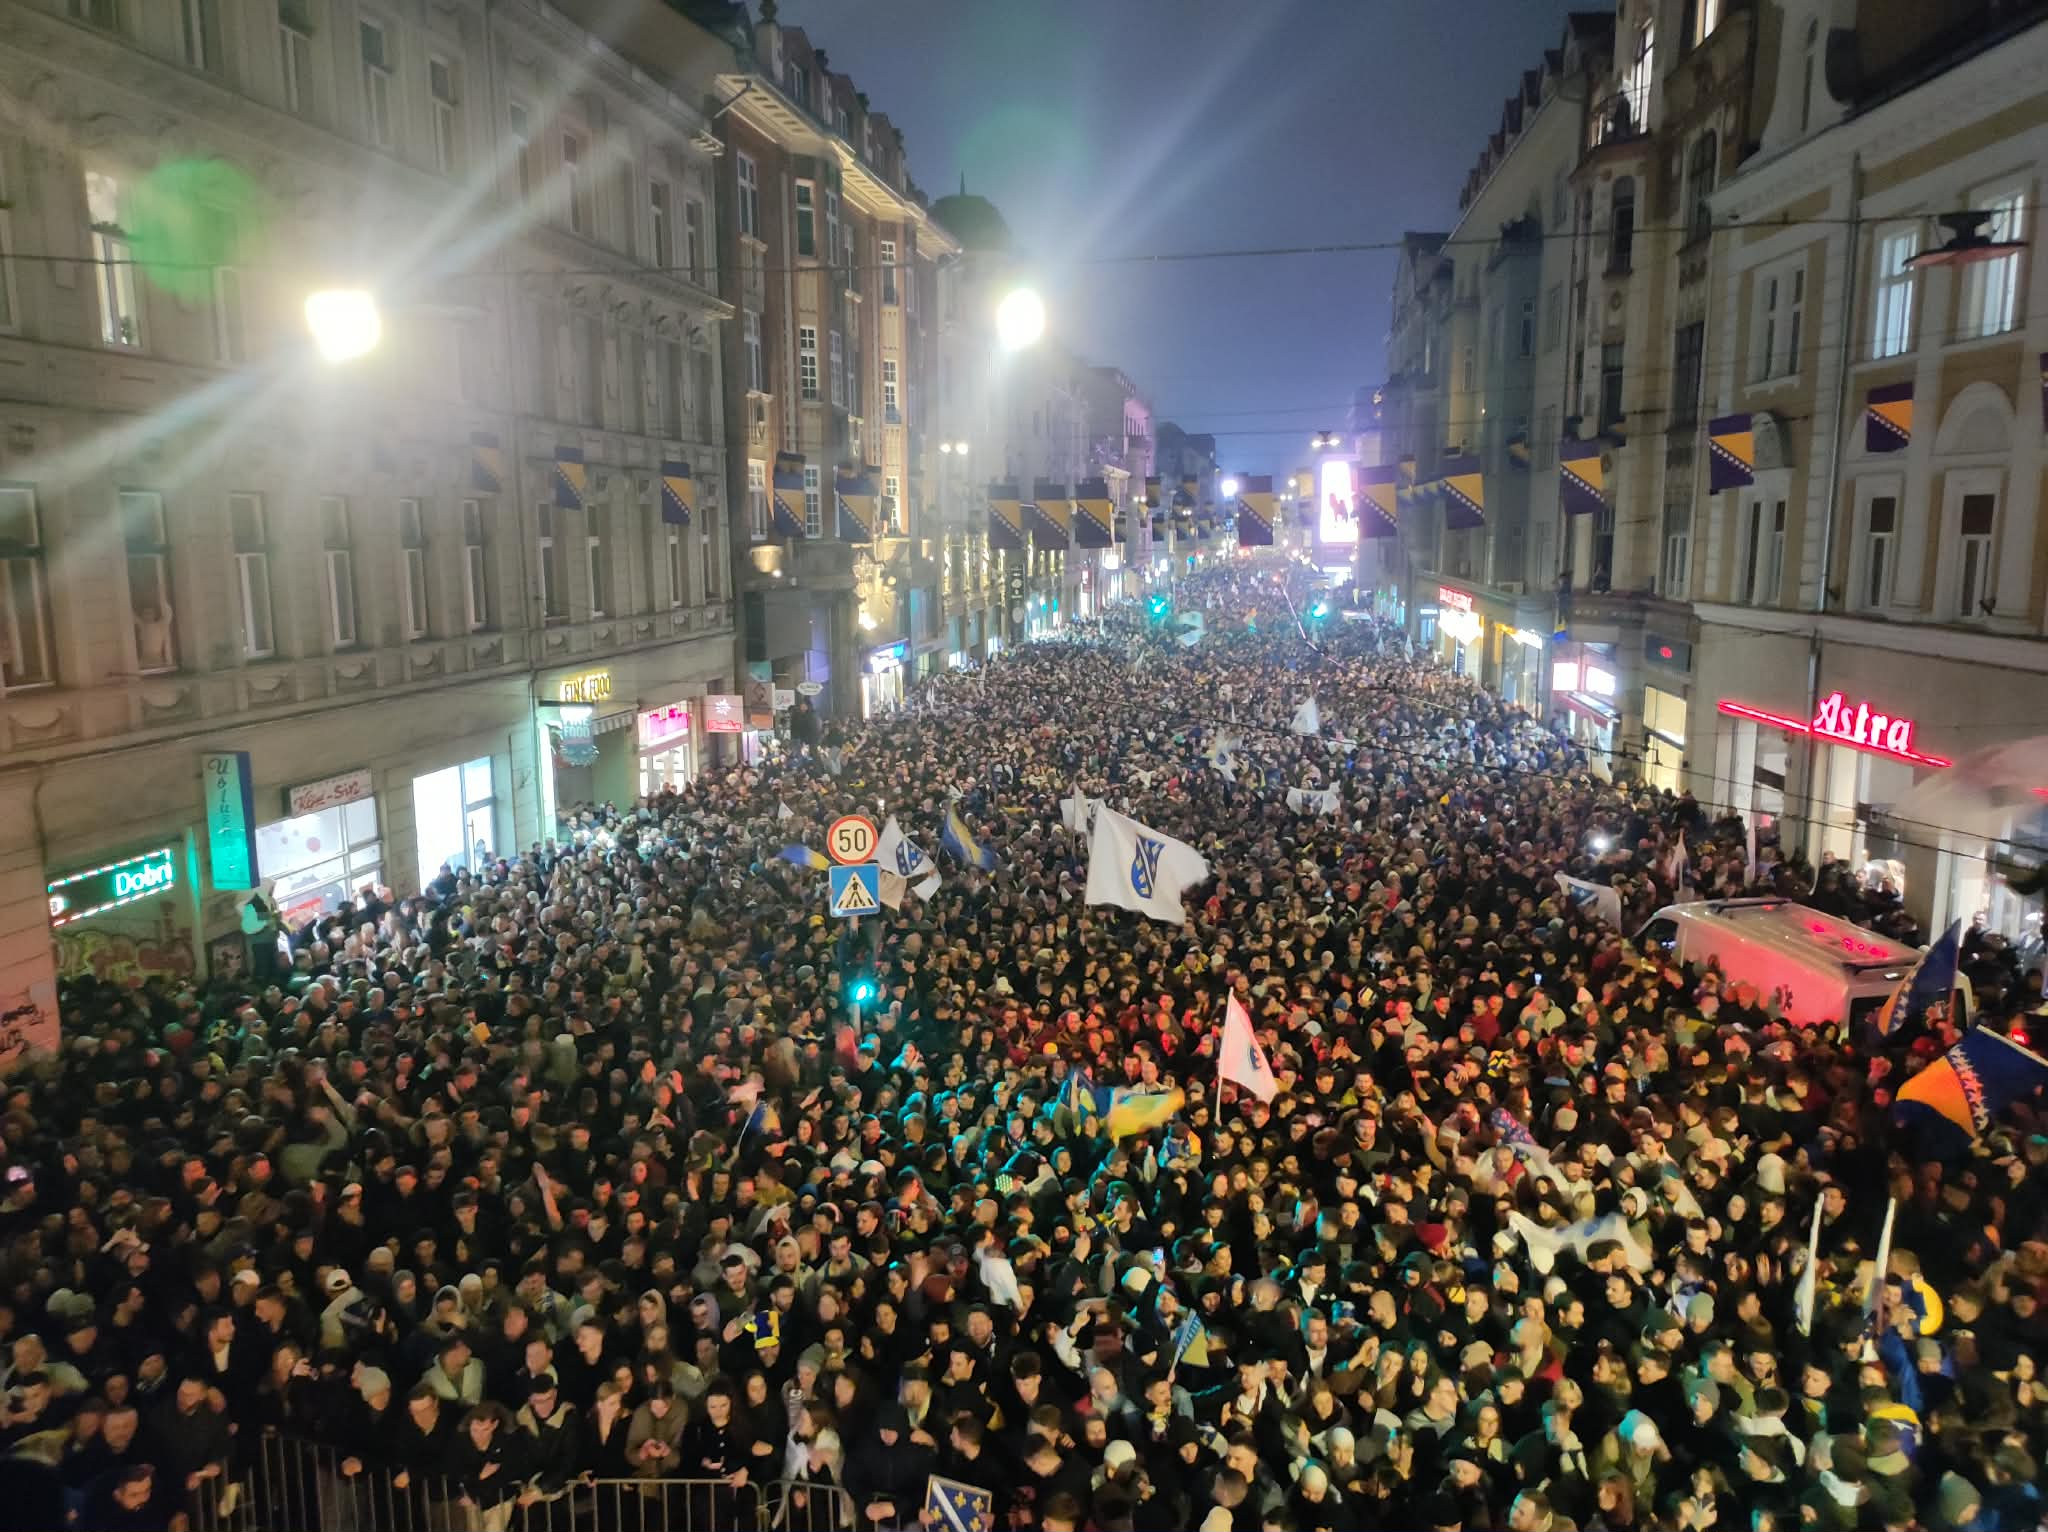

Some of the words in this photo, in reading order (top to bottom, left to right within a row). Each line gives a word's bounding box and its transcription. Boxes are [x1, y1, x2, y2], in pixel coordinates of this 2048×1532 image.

[563, 679, 587, 702] FINE
[588, 674, 611, 699] FOOD
[1813, 692, 1911, 752] Astra
[839, 828, 867, 853] 50
